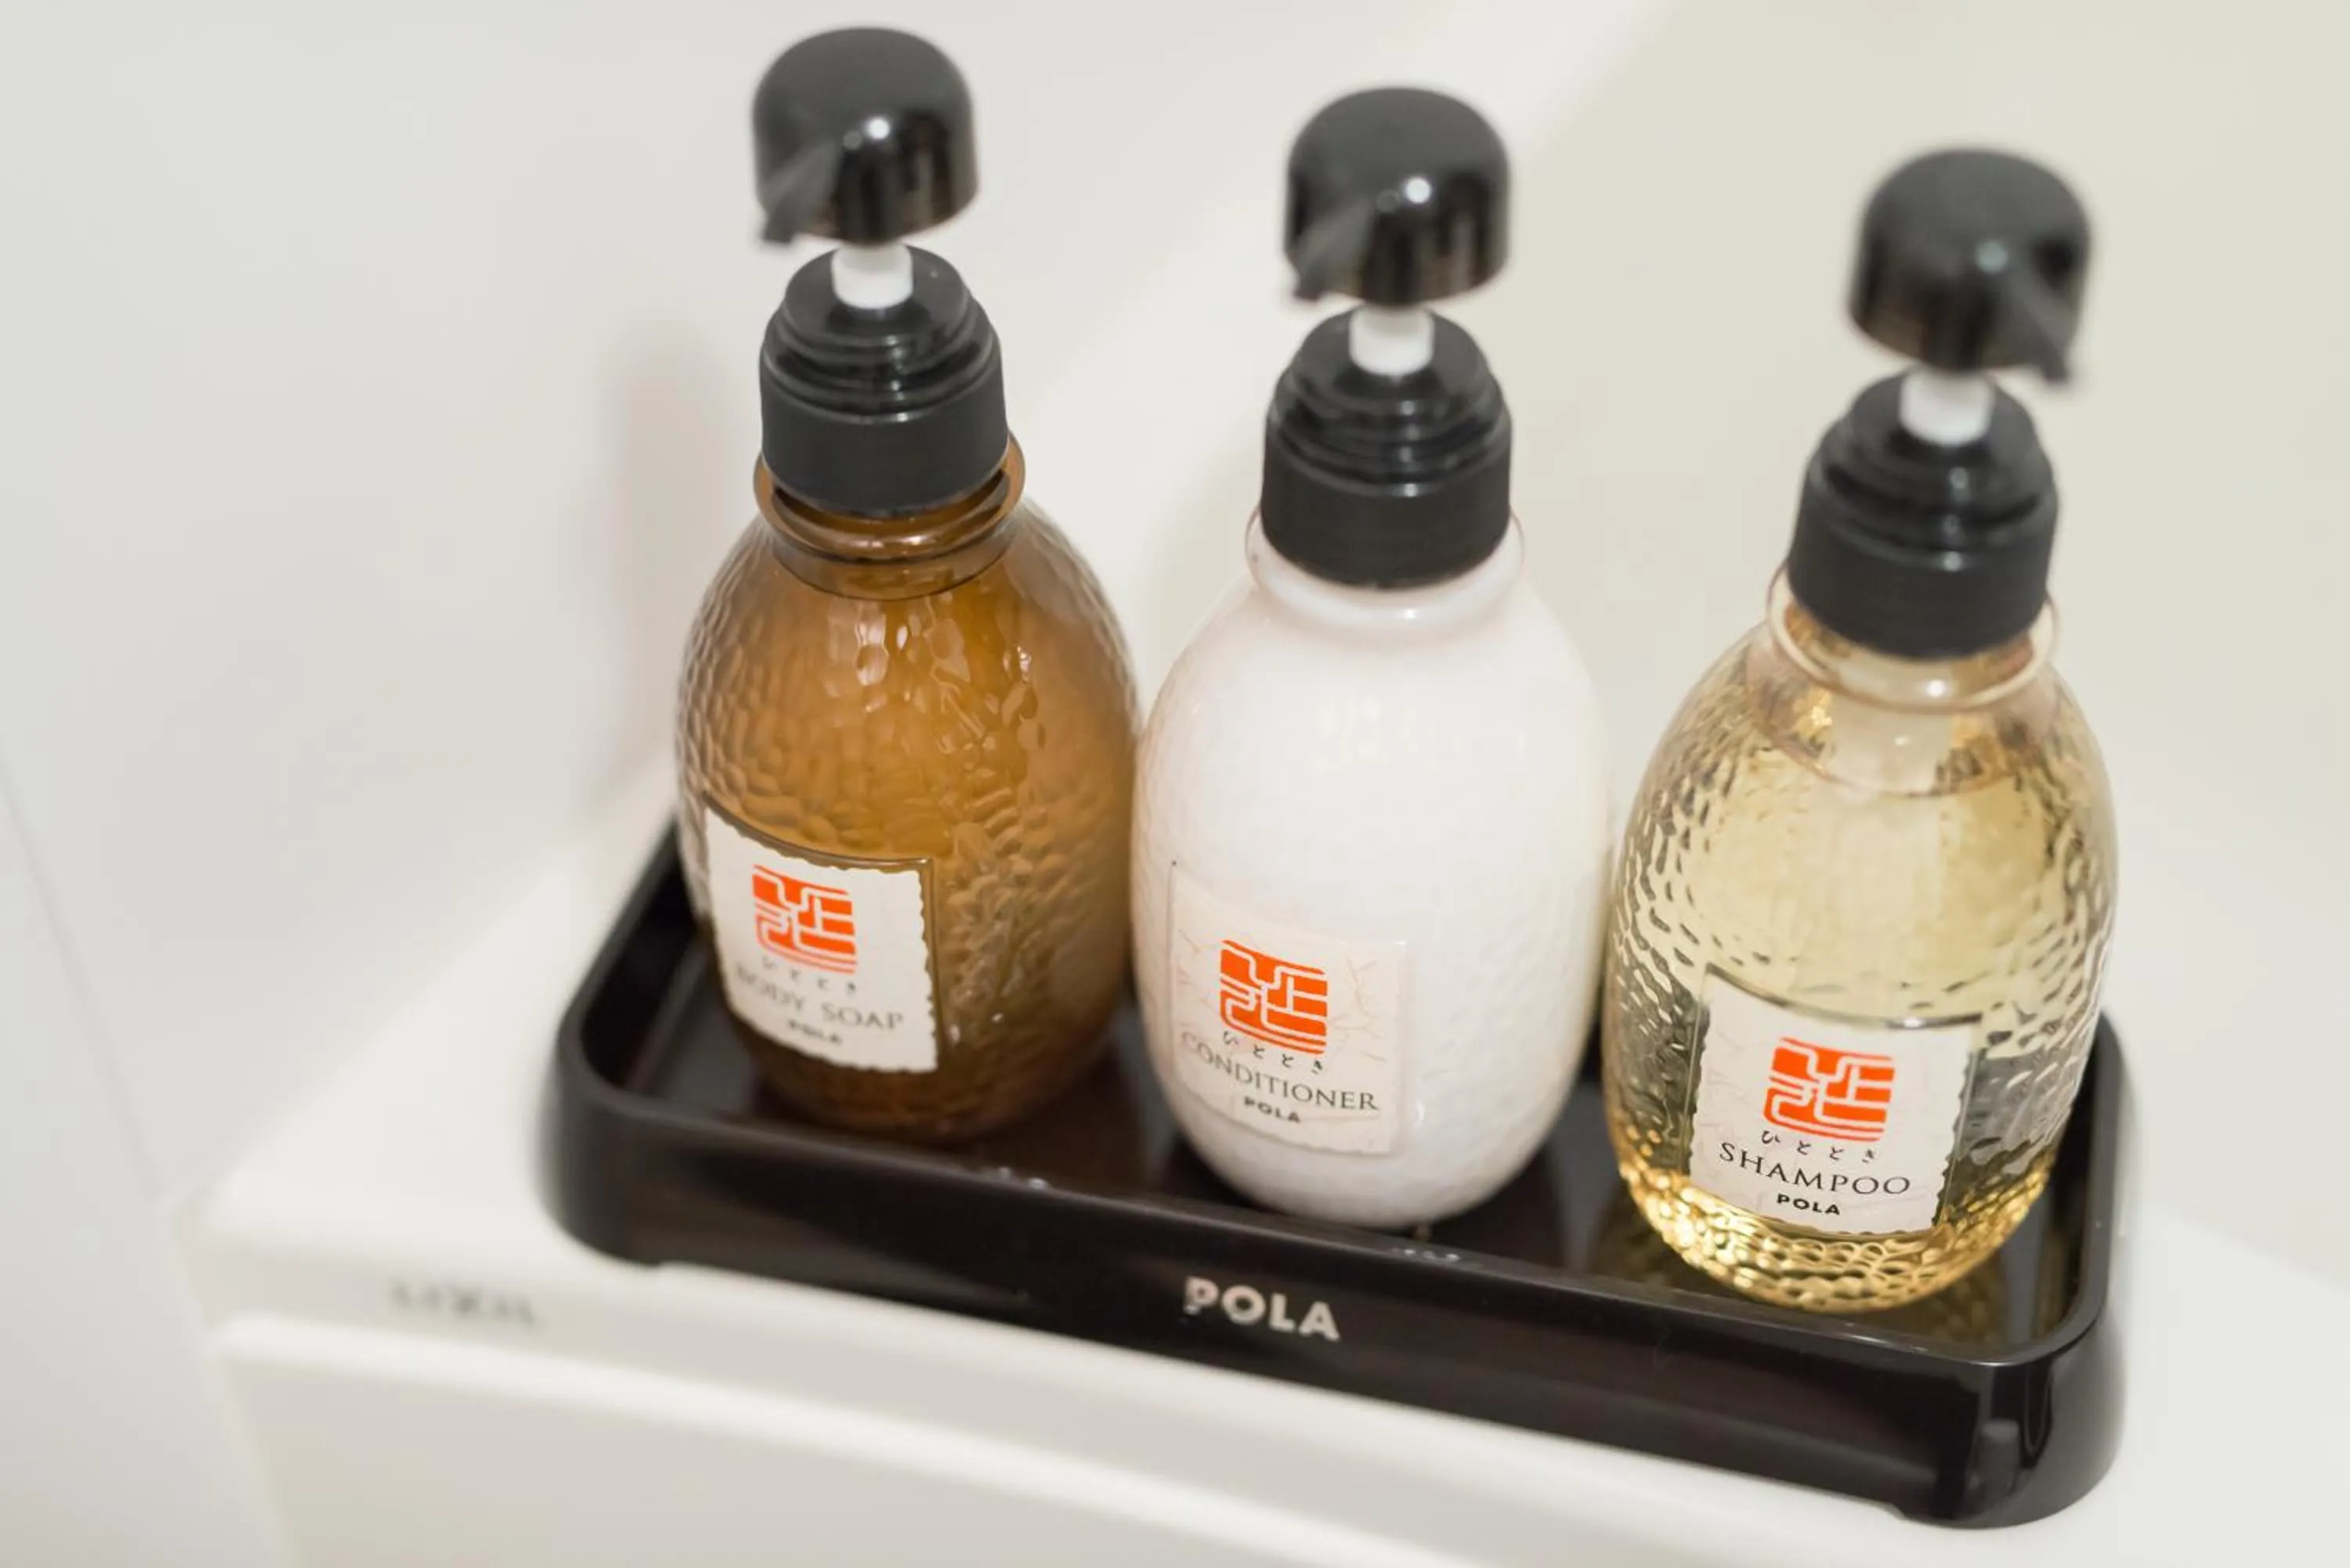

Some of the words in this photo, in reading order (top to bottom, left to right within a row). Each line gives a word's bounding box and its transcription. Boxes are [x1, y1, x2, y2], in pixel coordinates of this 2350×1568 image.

[821, 1002, 904, 1030] SOAP
[1181, 1031, 1379, 1111] CONDITIONER
[1244, 1097, 1301, 1123] POLA
[1761, 1130, 1876, 1164] ひととき
[1719, 1142, 1911, 1194] SHAMPOO
[1777, 1194, 1840, 1215] POLA
[1182, 1276, 1340, 1342] POLA
